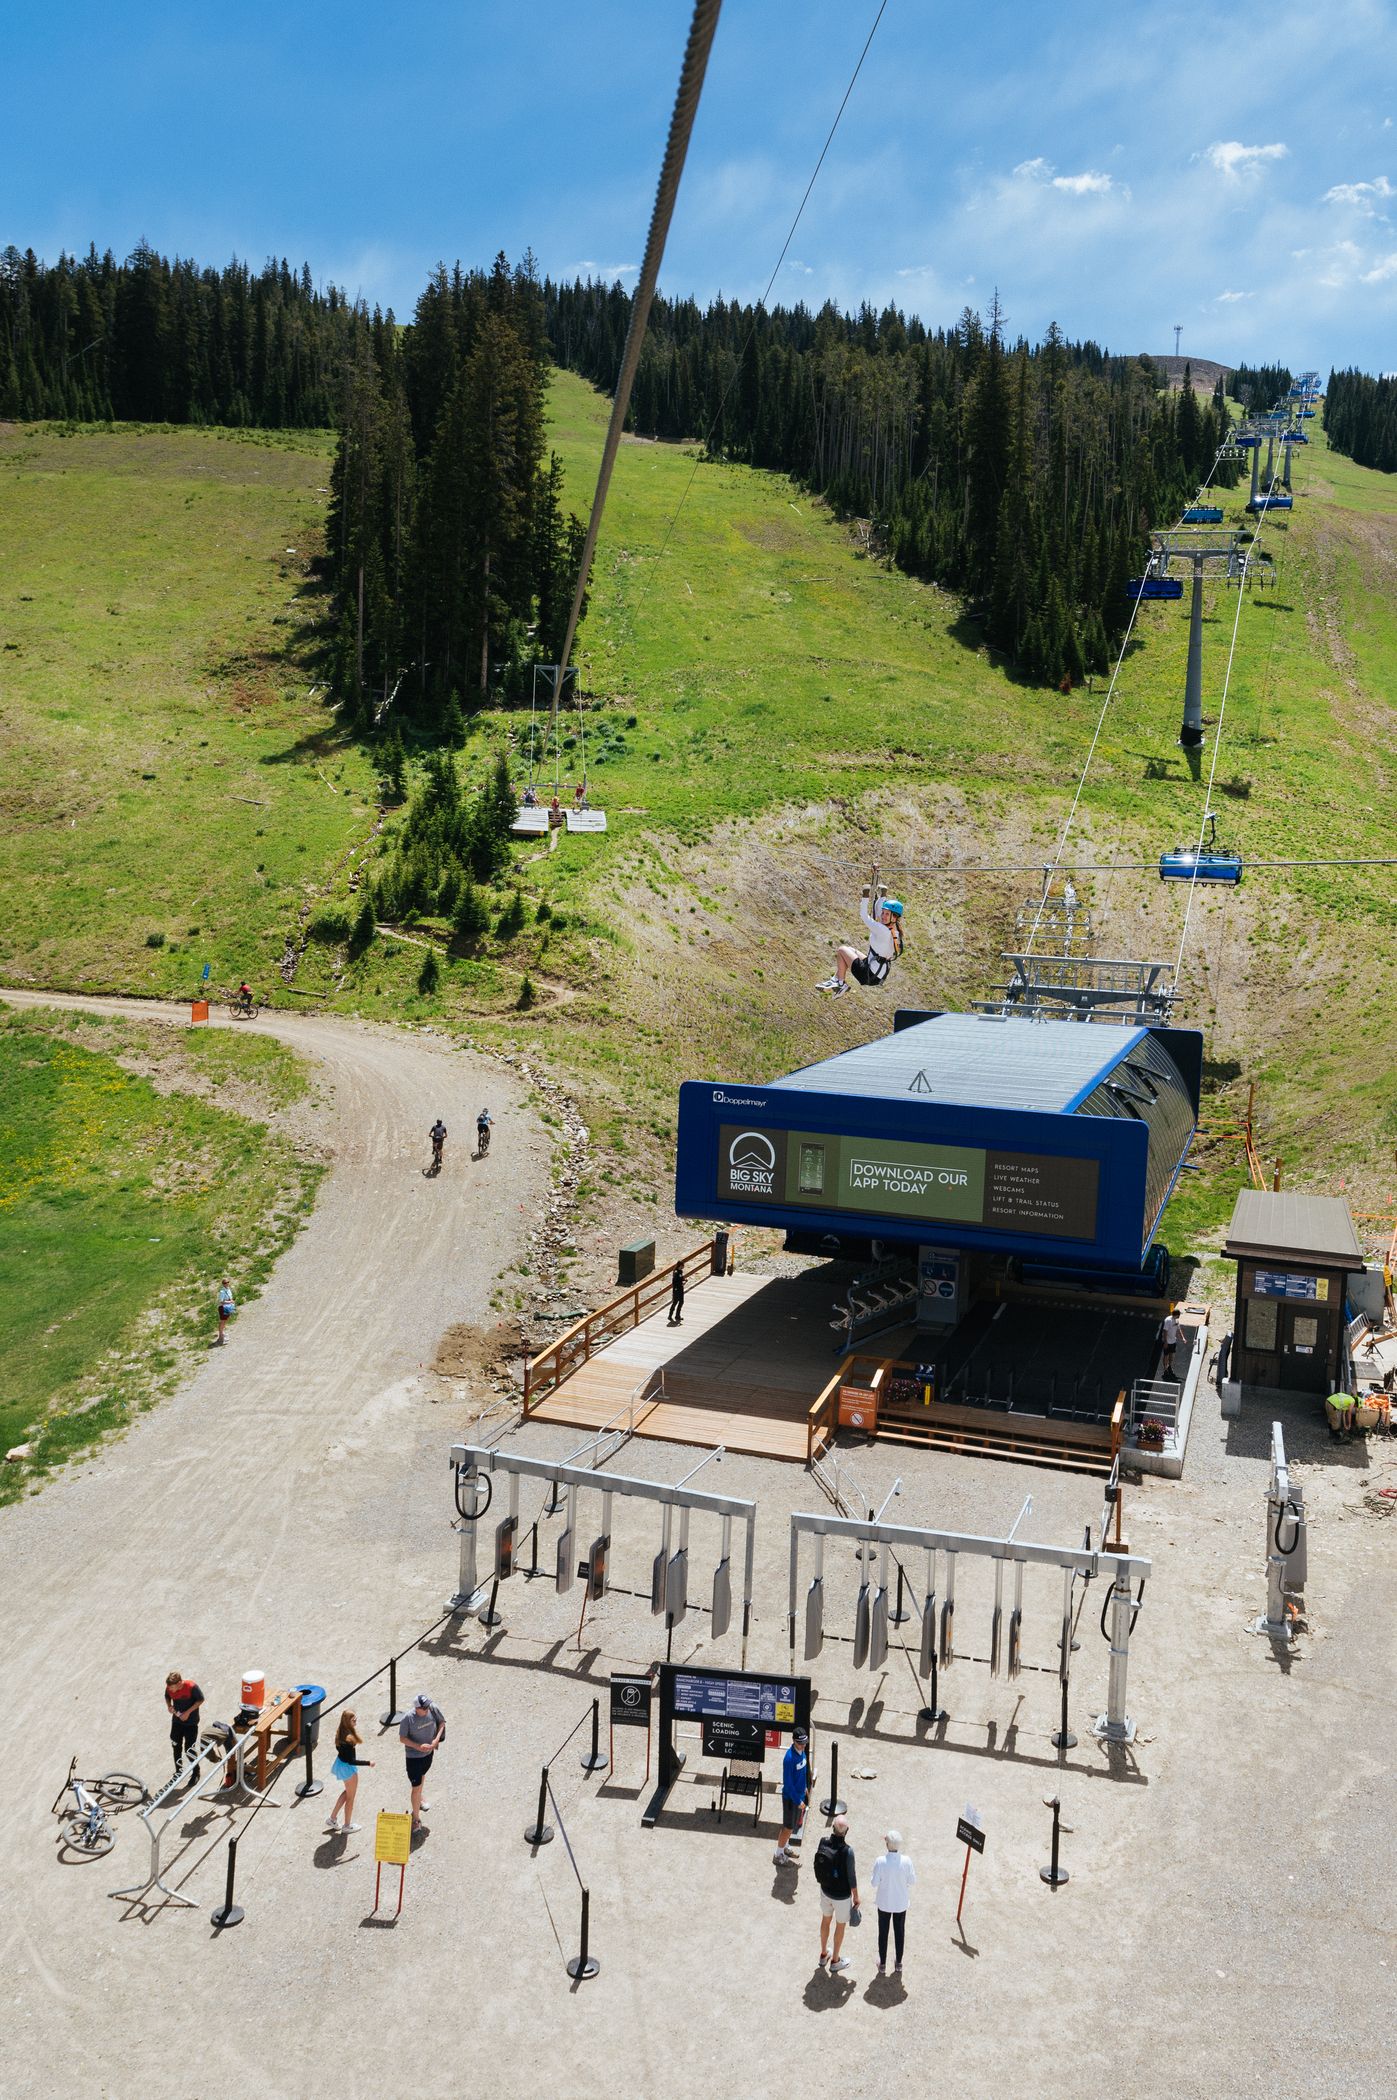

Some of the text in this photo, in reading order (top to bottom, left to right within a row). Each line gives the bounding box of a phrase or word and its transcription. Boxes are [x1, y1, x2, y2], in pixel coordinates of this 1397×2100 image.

[723, 1096, 767, 1107] Doppelmayr
[994, 1163, 1019, 1171] RESORT
[730, 1168, 775, 1184] BIG SKY
[853, 1163, 968, 1186] DOWNLOAD OUR
[1010, 1176, 1040, 1185] WEATHER
[730, 1182, 773, 1194] MONTANA
[853, 1177, 928, 1195] APP TODAY
[993, 1186, 1025, 1194] WEBCAMS
[1016, 1198, 1033, 1206] TRAIL
[1035, 1200, 1060, 1208] STATUS
[992, 1207, 1064, 1220] RESORT INFORMATION
[712, 1721, 735, 1729] SCENIC
[712, 1728, 740, 1736] LOADING
